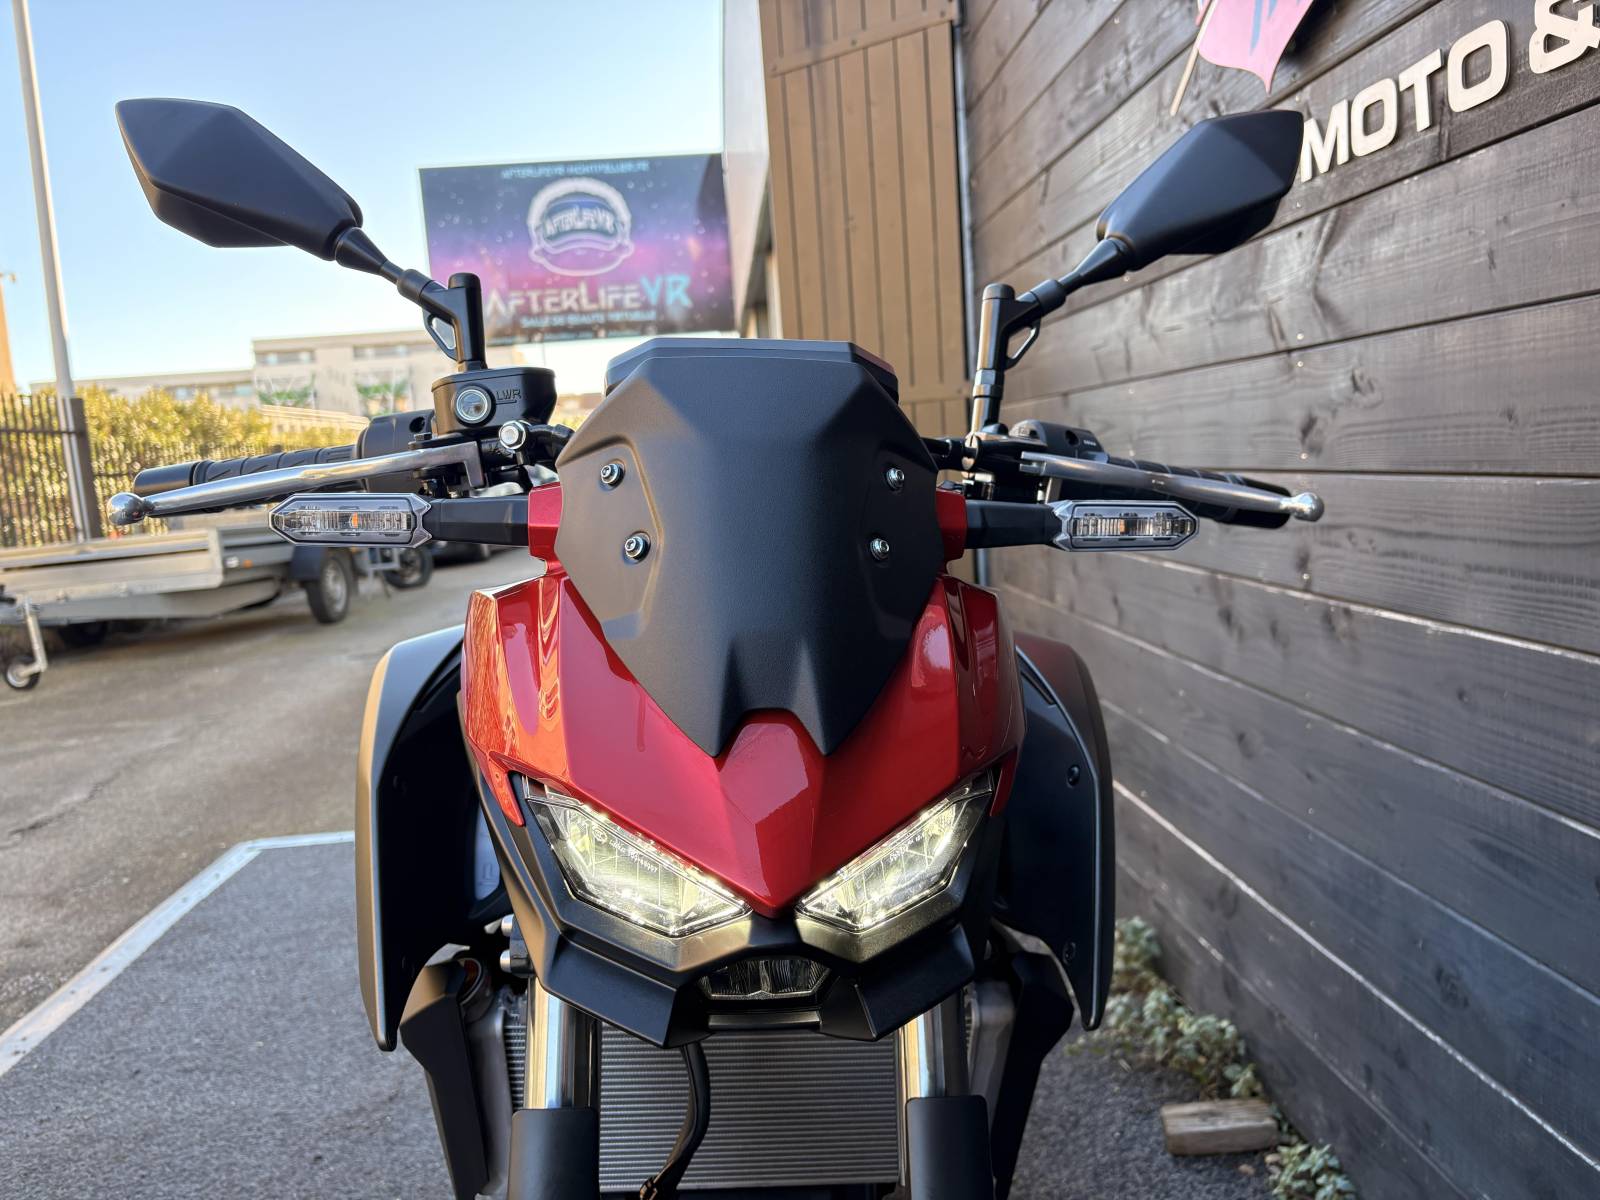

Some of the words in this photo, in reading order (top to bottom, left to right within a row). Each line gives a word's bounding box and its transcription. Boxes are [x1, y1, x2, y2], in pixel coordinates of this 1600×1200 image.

[1301, 19, 1511, 183] MOTO
[1529, 0, 1600, 74] &
[496, 389, 521, 401] LWR
